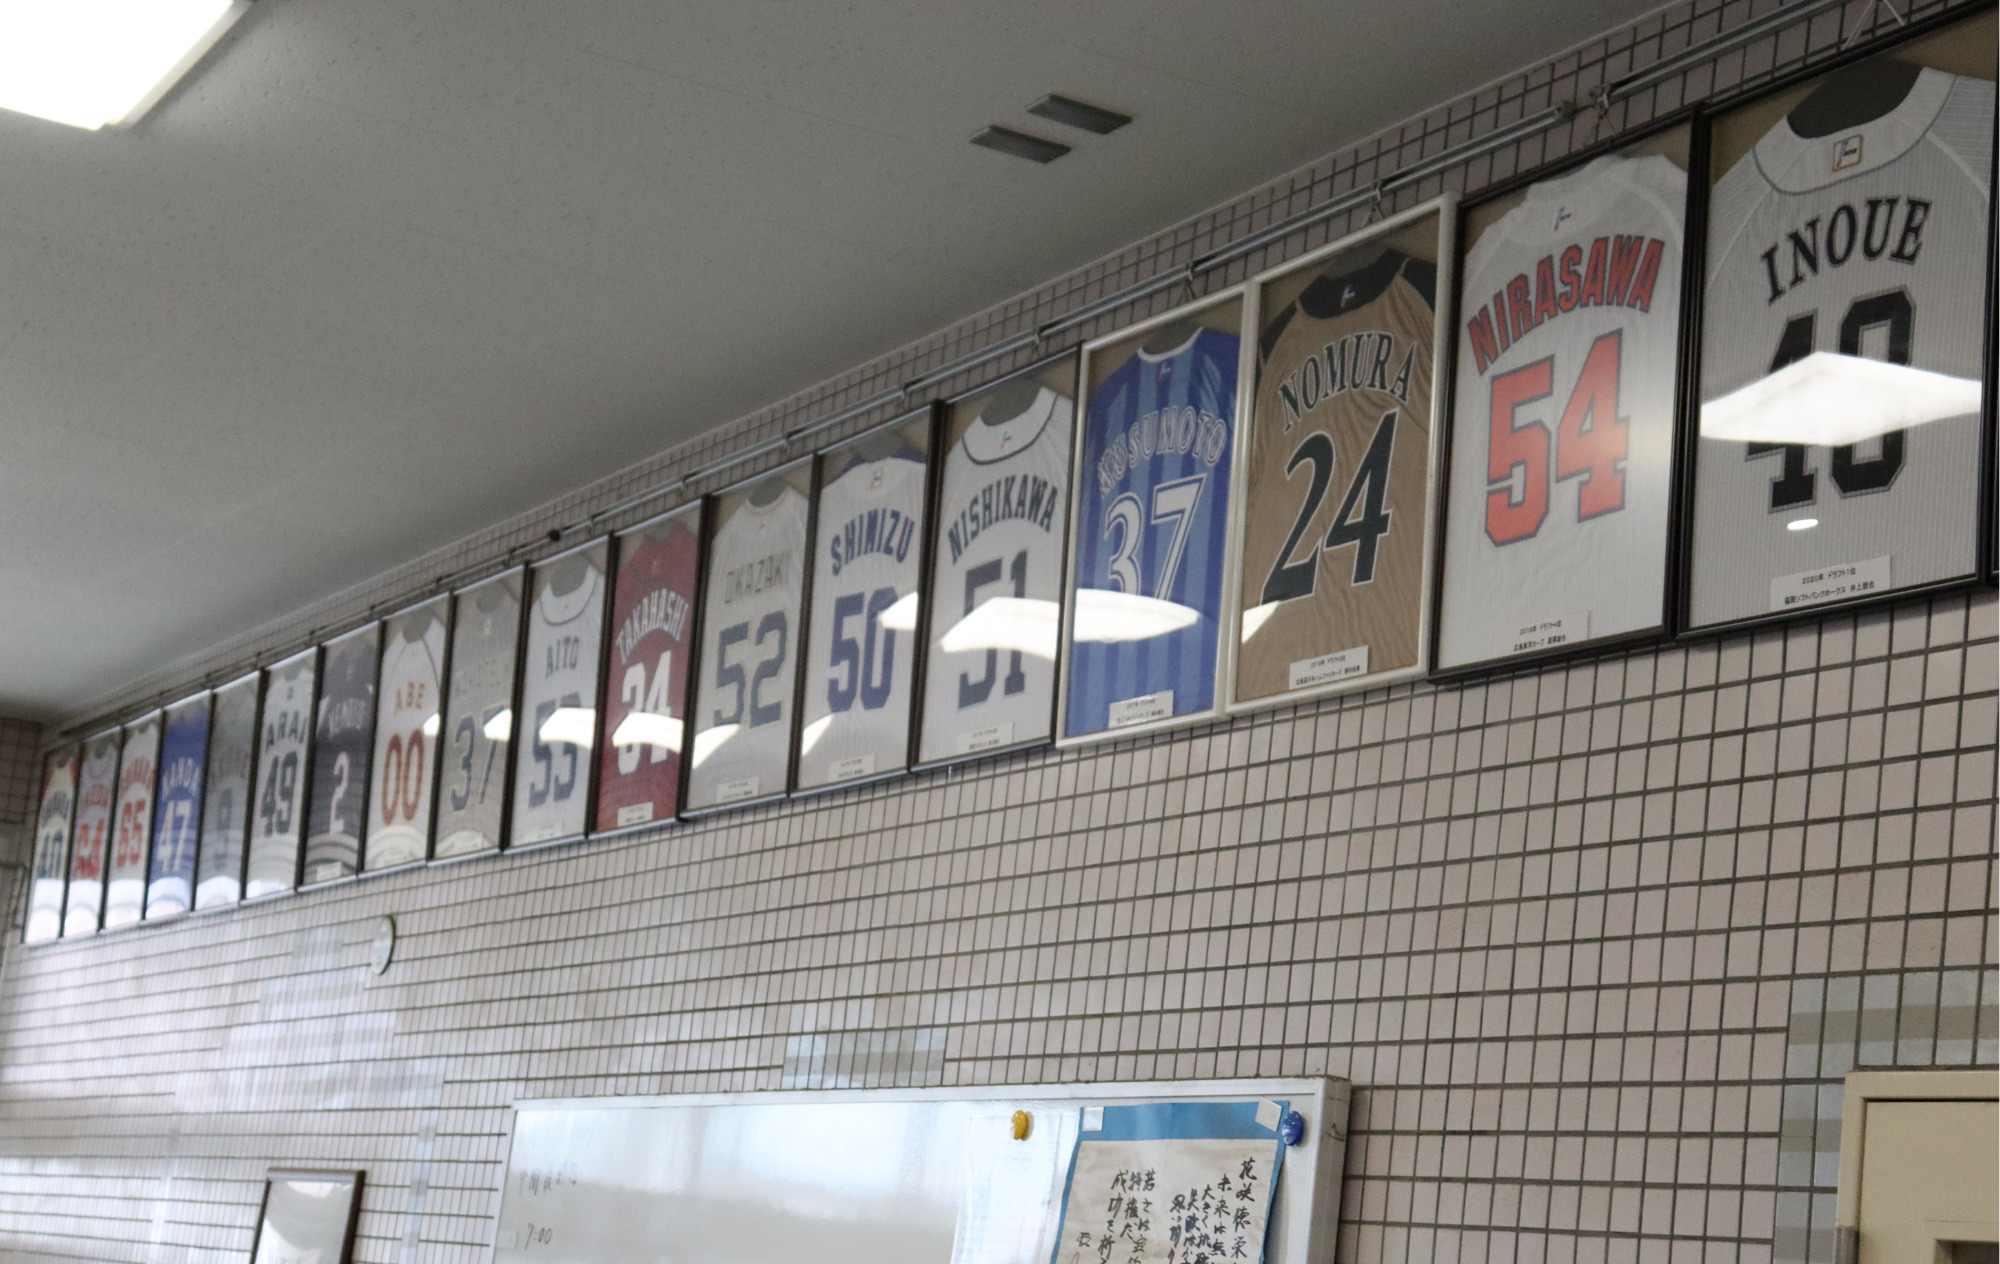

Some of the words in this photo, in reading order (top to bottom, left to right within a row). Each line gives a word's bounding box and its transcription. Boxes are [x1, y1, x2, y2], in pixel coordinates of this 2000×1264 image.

[1761, 196, 1931, 304] INOUE
[1467, 234, 1665, 376] NIRASAWA
[1278, 331, 1418, 432] NOMURA
[1485, 328, 1629, 548] 54
[831, 507, 915, 576] SHIMIZU
[947, 472, 1059, 566] NISHIKAWA
[1102, 472, 1207, 601] 37
[1261, 406, 1400, 606] 24
[546, 635, 580, 679] AITO
[616, 588, 689, 664] TAKAHASHI
[713, 610, 787, 729] 52
[827, 585, 899, 713] 50
[958, 548, 1028, 709] 51
[395, 681, 427, 716] ABE
[618, 650, 672, 776] 34
[260, 751, 298, 838] 49
[329, 751, 350, 835] 2
[381, 728, 425, 826] 00
[156, 800, 193, 873] 47
[525, 1222, 552, 1250] 7:00
